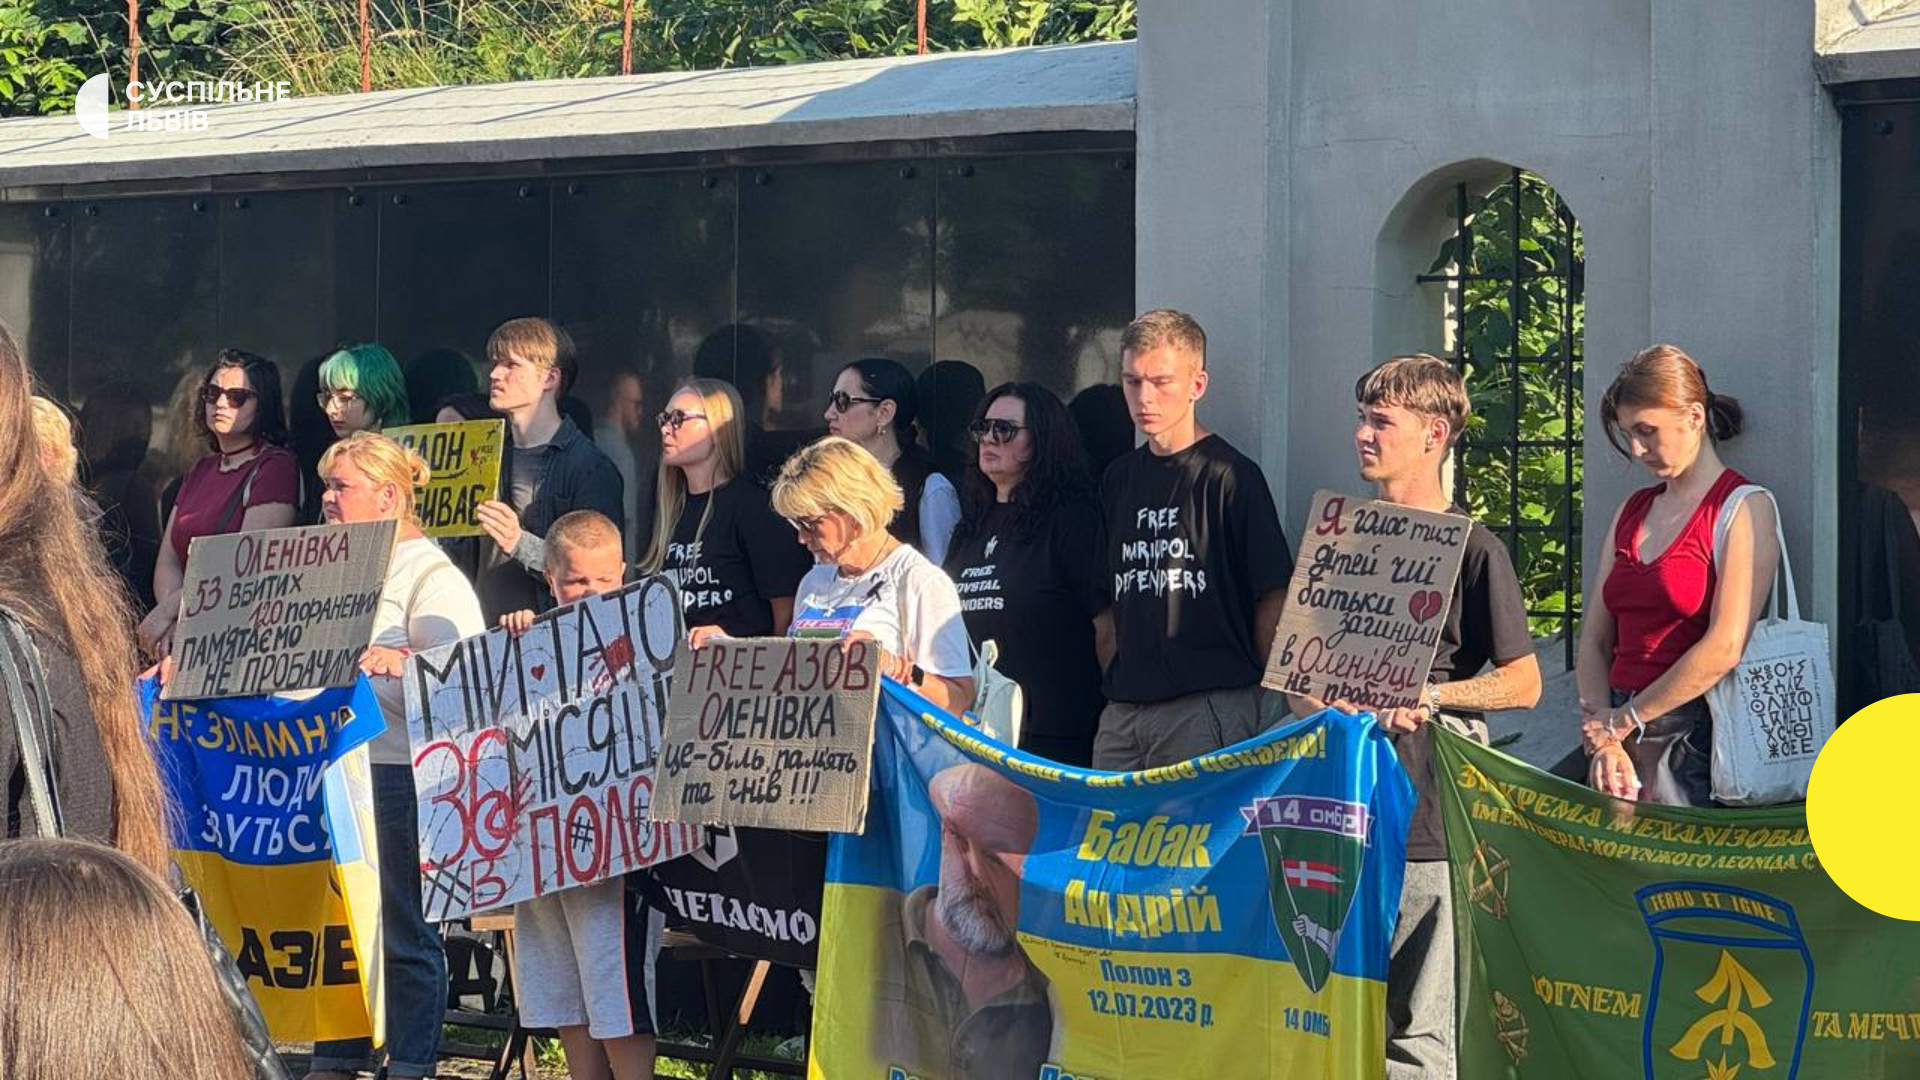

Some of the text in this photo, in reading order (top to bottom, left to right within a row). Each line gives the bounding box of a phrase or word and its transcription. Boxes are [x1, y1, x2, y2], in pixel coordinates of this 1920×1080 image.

[1137, 507, 1179, 537] FREE
[1316, 497, 1462, 546] Я голос тих
[666, 541, 703, 566] FREE
[961, 565, 996, 578] FREE
[1308, 541, 1441, 585] дітей чиї
[186, 572, 303, 618] 53 ВБИТИХ
[1115, 568, 1206, 602] DEFENDERS
[1297, 577, 1395, 616] батьки
[249, 599, 283, 630] 120
[1326, 612, 1440, 657] загинули
[179, 623, 303, 671] ПАМ'ЯТАЄМО
[533, 575, 684, 704] ТАТО
[201, 644, 368, 695] НЕ ПРОБАЧИМ
[687, 639, 870, 693] FREE АЗОВ
[1280, 634, 1418, 691] в Оленівці
[1284, 671, 1311, 694] не
[699, 690, 837, 740] ОЛЕНІВКА
[413, 726, 514, 871] 36
[682, 781, 714, 805] та
[1267, 799, 1300, 824] 14
[1489, 778, 1603, 827] КРЕМА
[1077, 808, 1213, 868] Бабак
[663, 885, 817, 945] ЧЕКАЄМО
[1064, 879, 1222, 938] Андрій
[1100, 958, 1173, 987] Полон
[1087, 989, 1215, 1027] 12.07.2023 р.
[1531, 974, 1642, 1018] ОГНЕМ
[1283, 1007, 1300, 1031] 14
[1812, 1011, 1844, 1038] ТА
